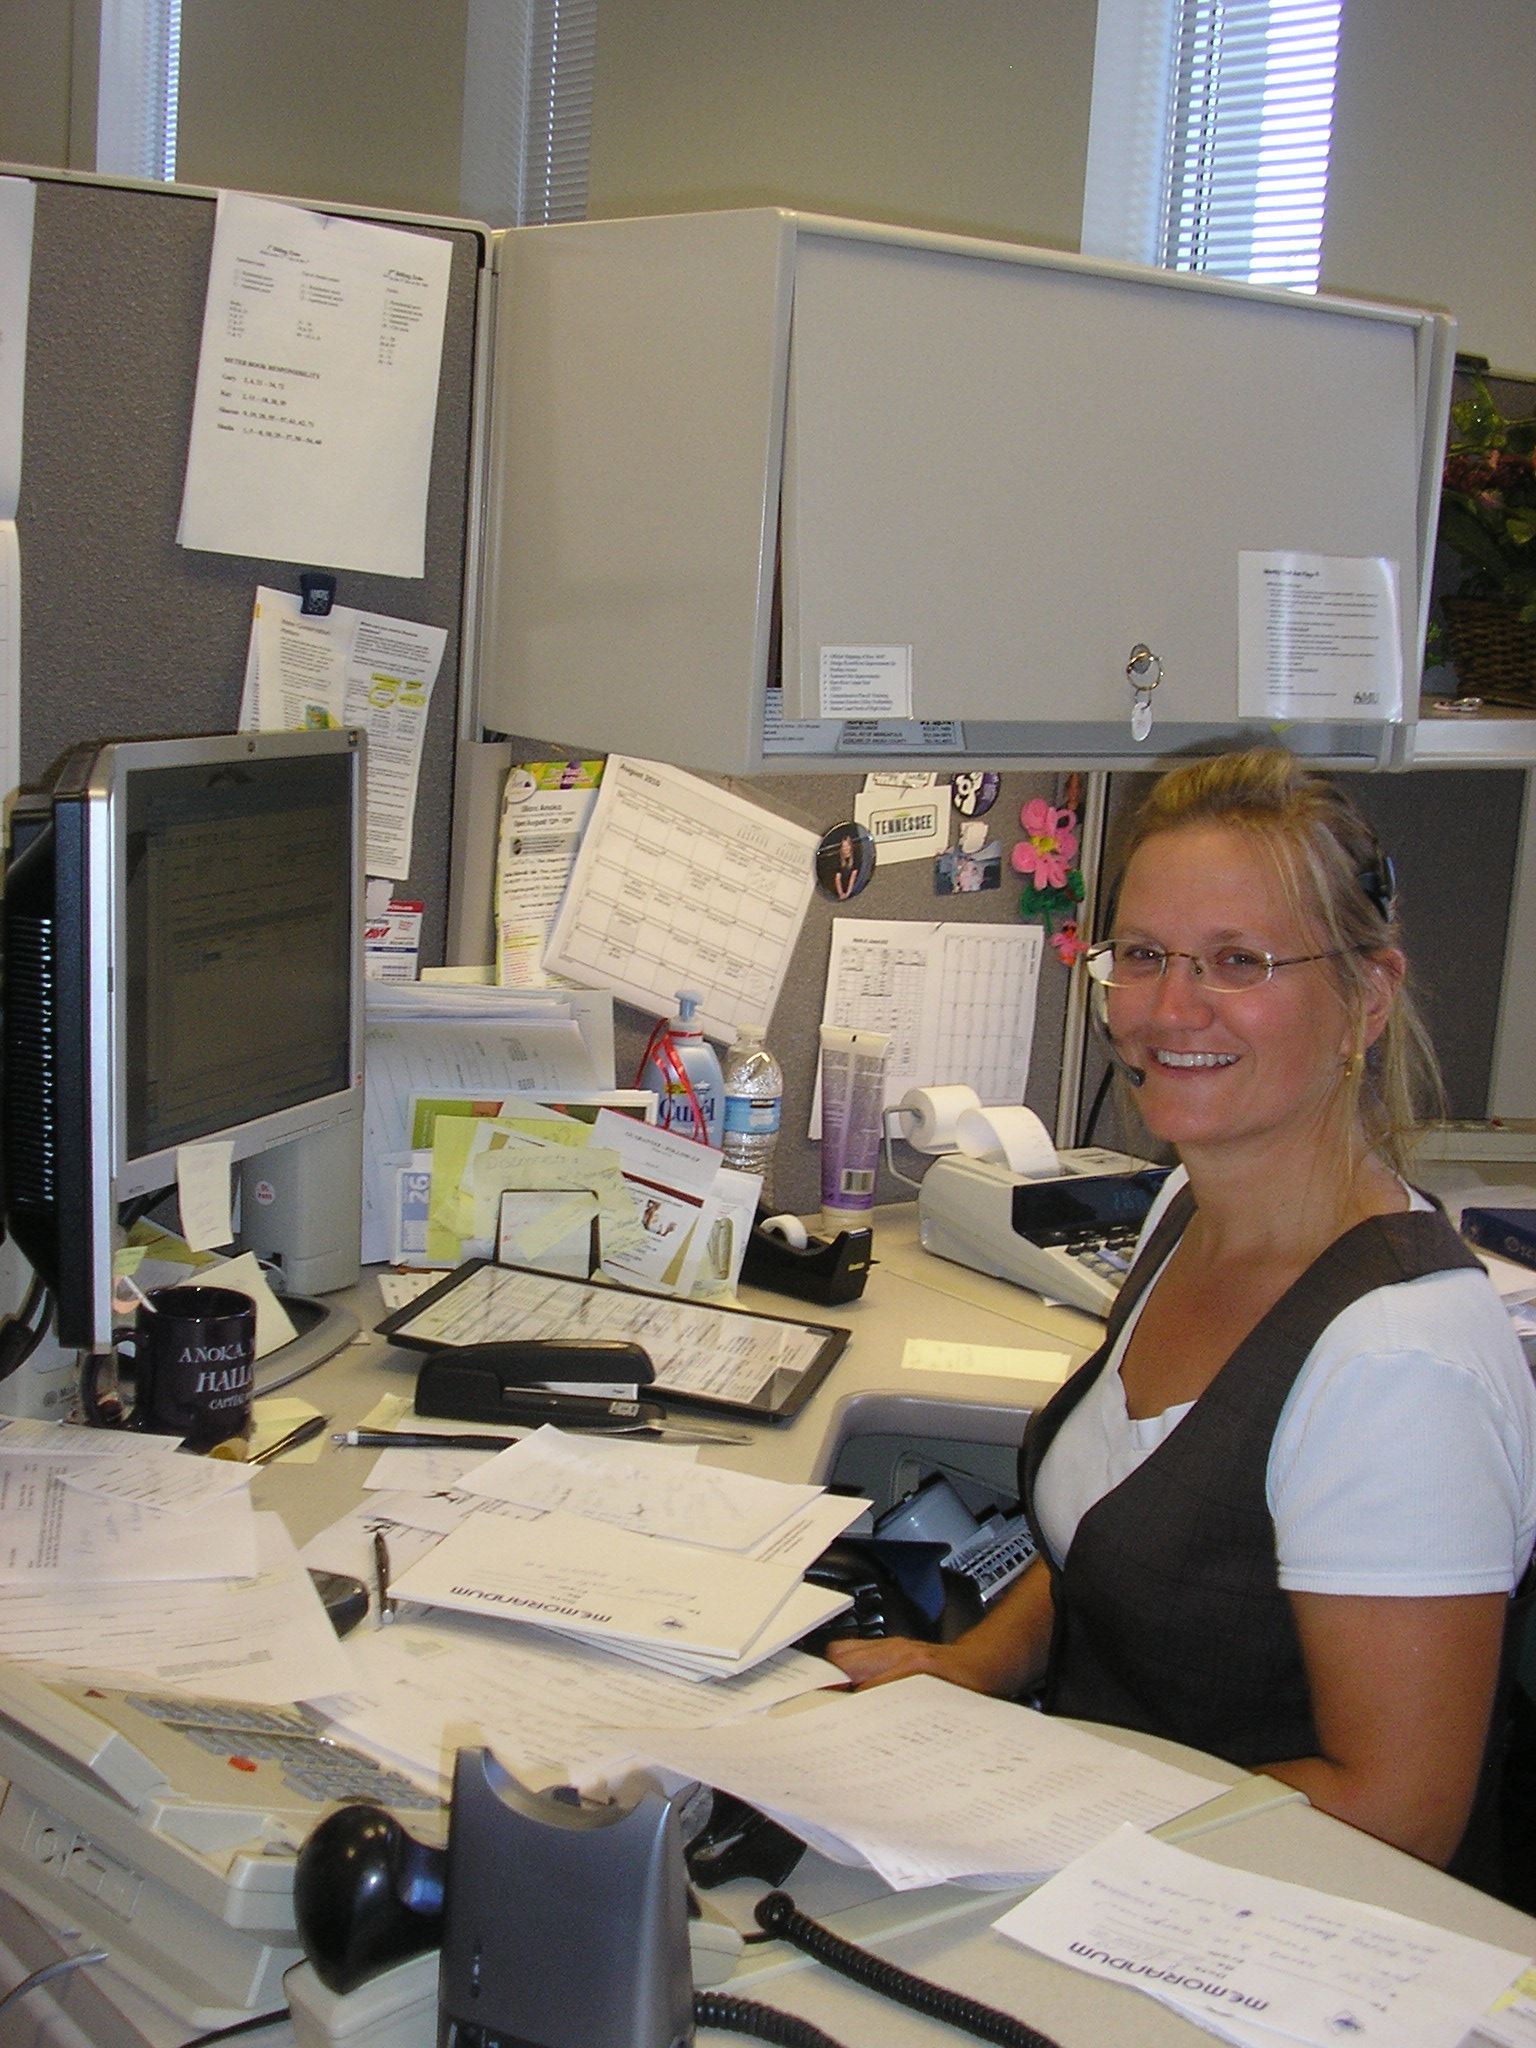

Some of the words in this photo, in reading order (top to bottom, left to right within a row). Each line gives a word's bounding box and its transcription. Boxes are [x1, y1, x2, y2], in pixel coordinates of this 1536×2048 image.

[619, 763, 644, 783] August
[875, 814, 932, 836] TENNESSEE
[178, 1343, 246, 1364] ANOKA
[450, 1586, 612, 1623] MEMORANDUM
[1069, 1941, 1269, 2012] MEMORANDUM
